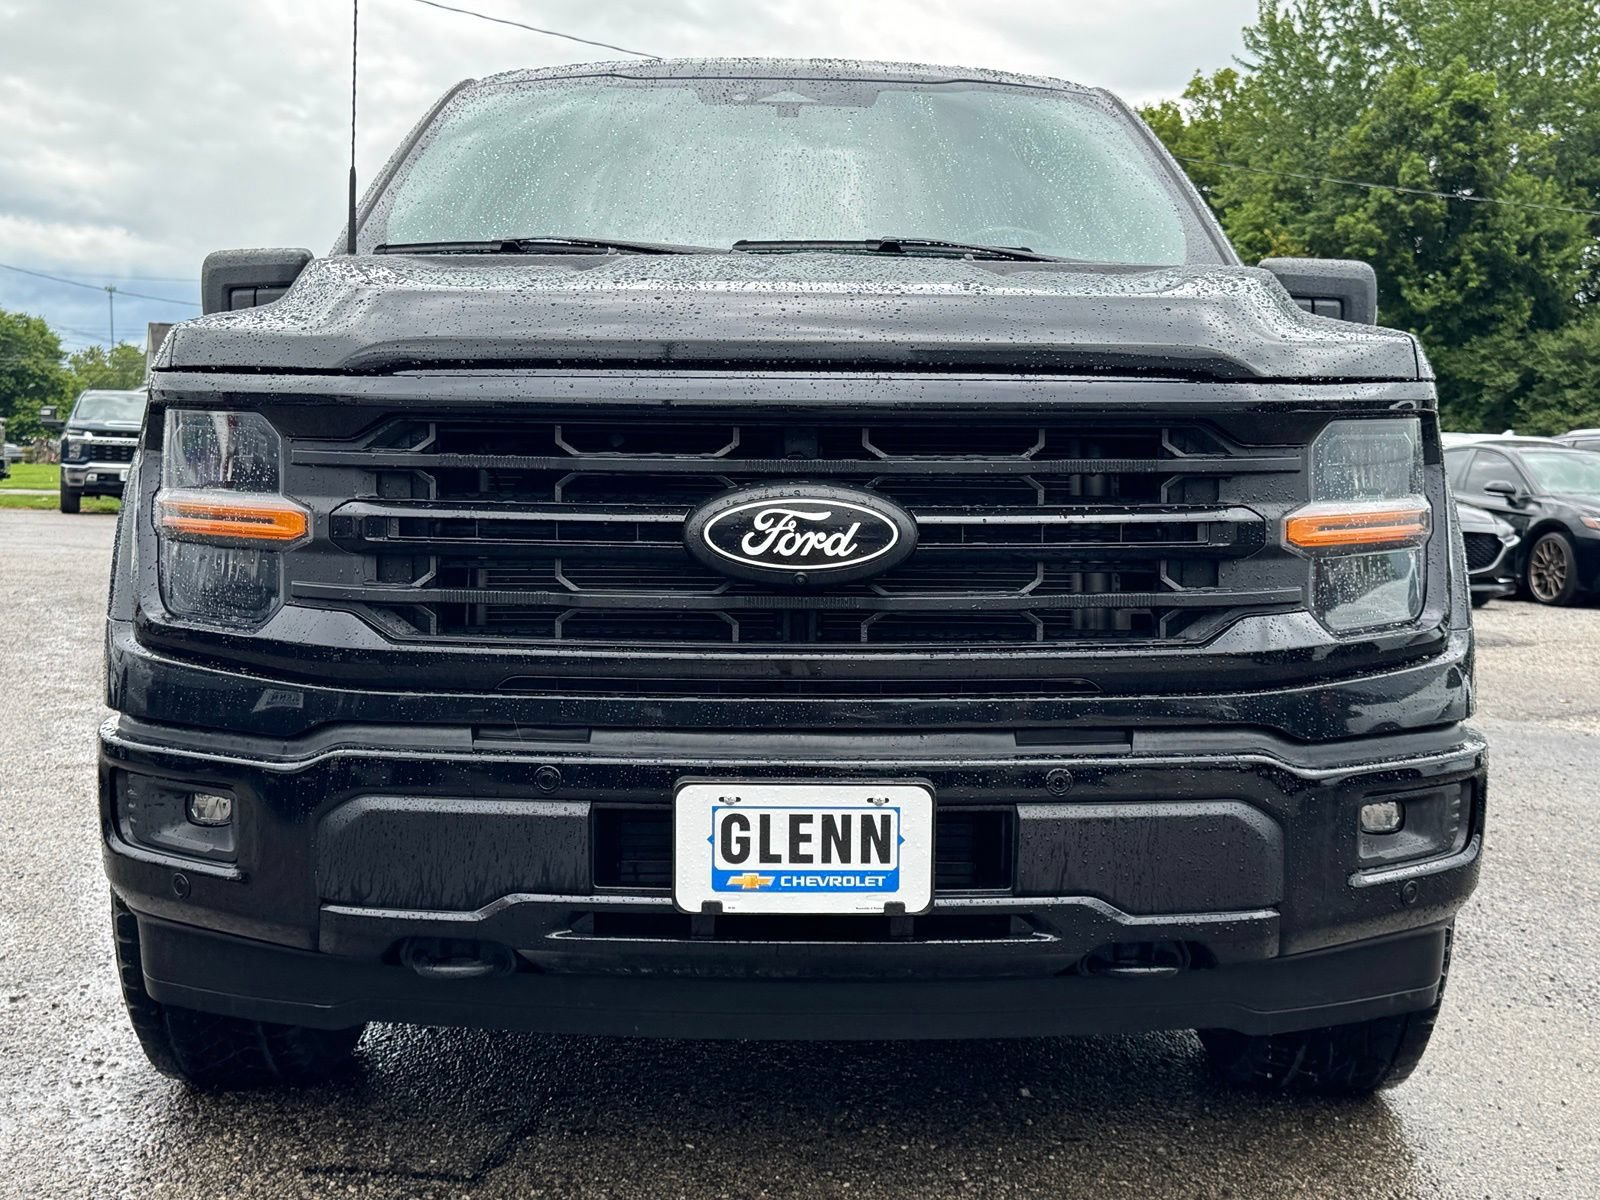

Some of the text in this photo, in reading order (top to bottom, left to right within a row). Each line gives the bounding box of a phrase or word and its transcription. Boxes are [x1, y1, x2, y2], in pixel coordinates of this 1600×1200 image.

[741, 508, 861, 557] Ford
[720, 812, 892, 864] GLENN
[779, 875, 887, 888] CHEVROLET
